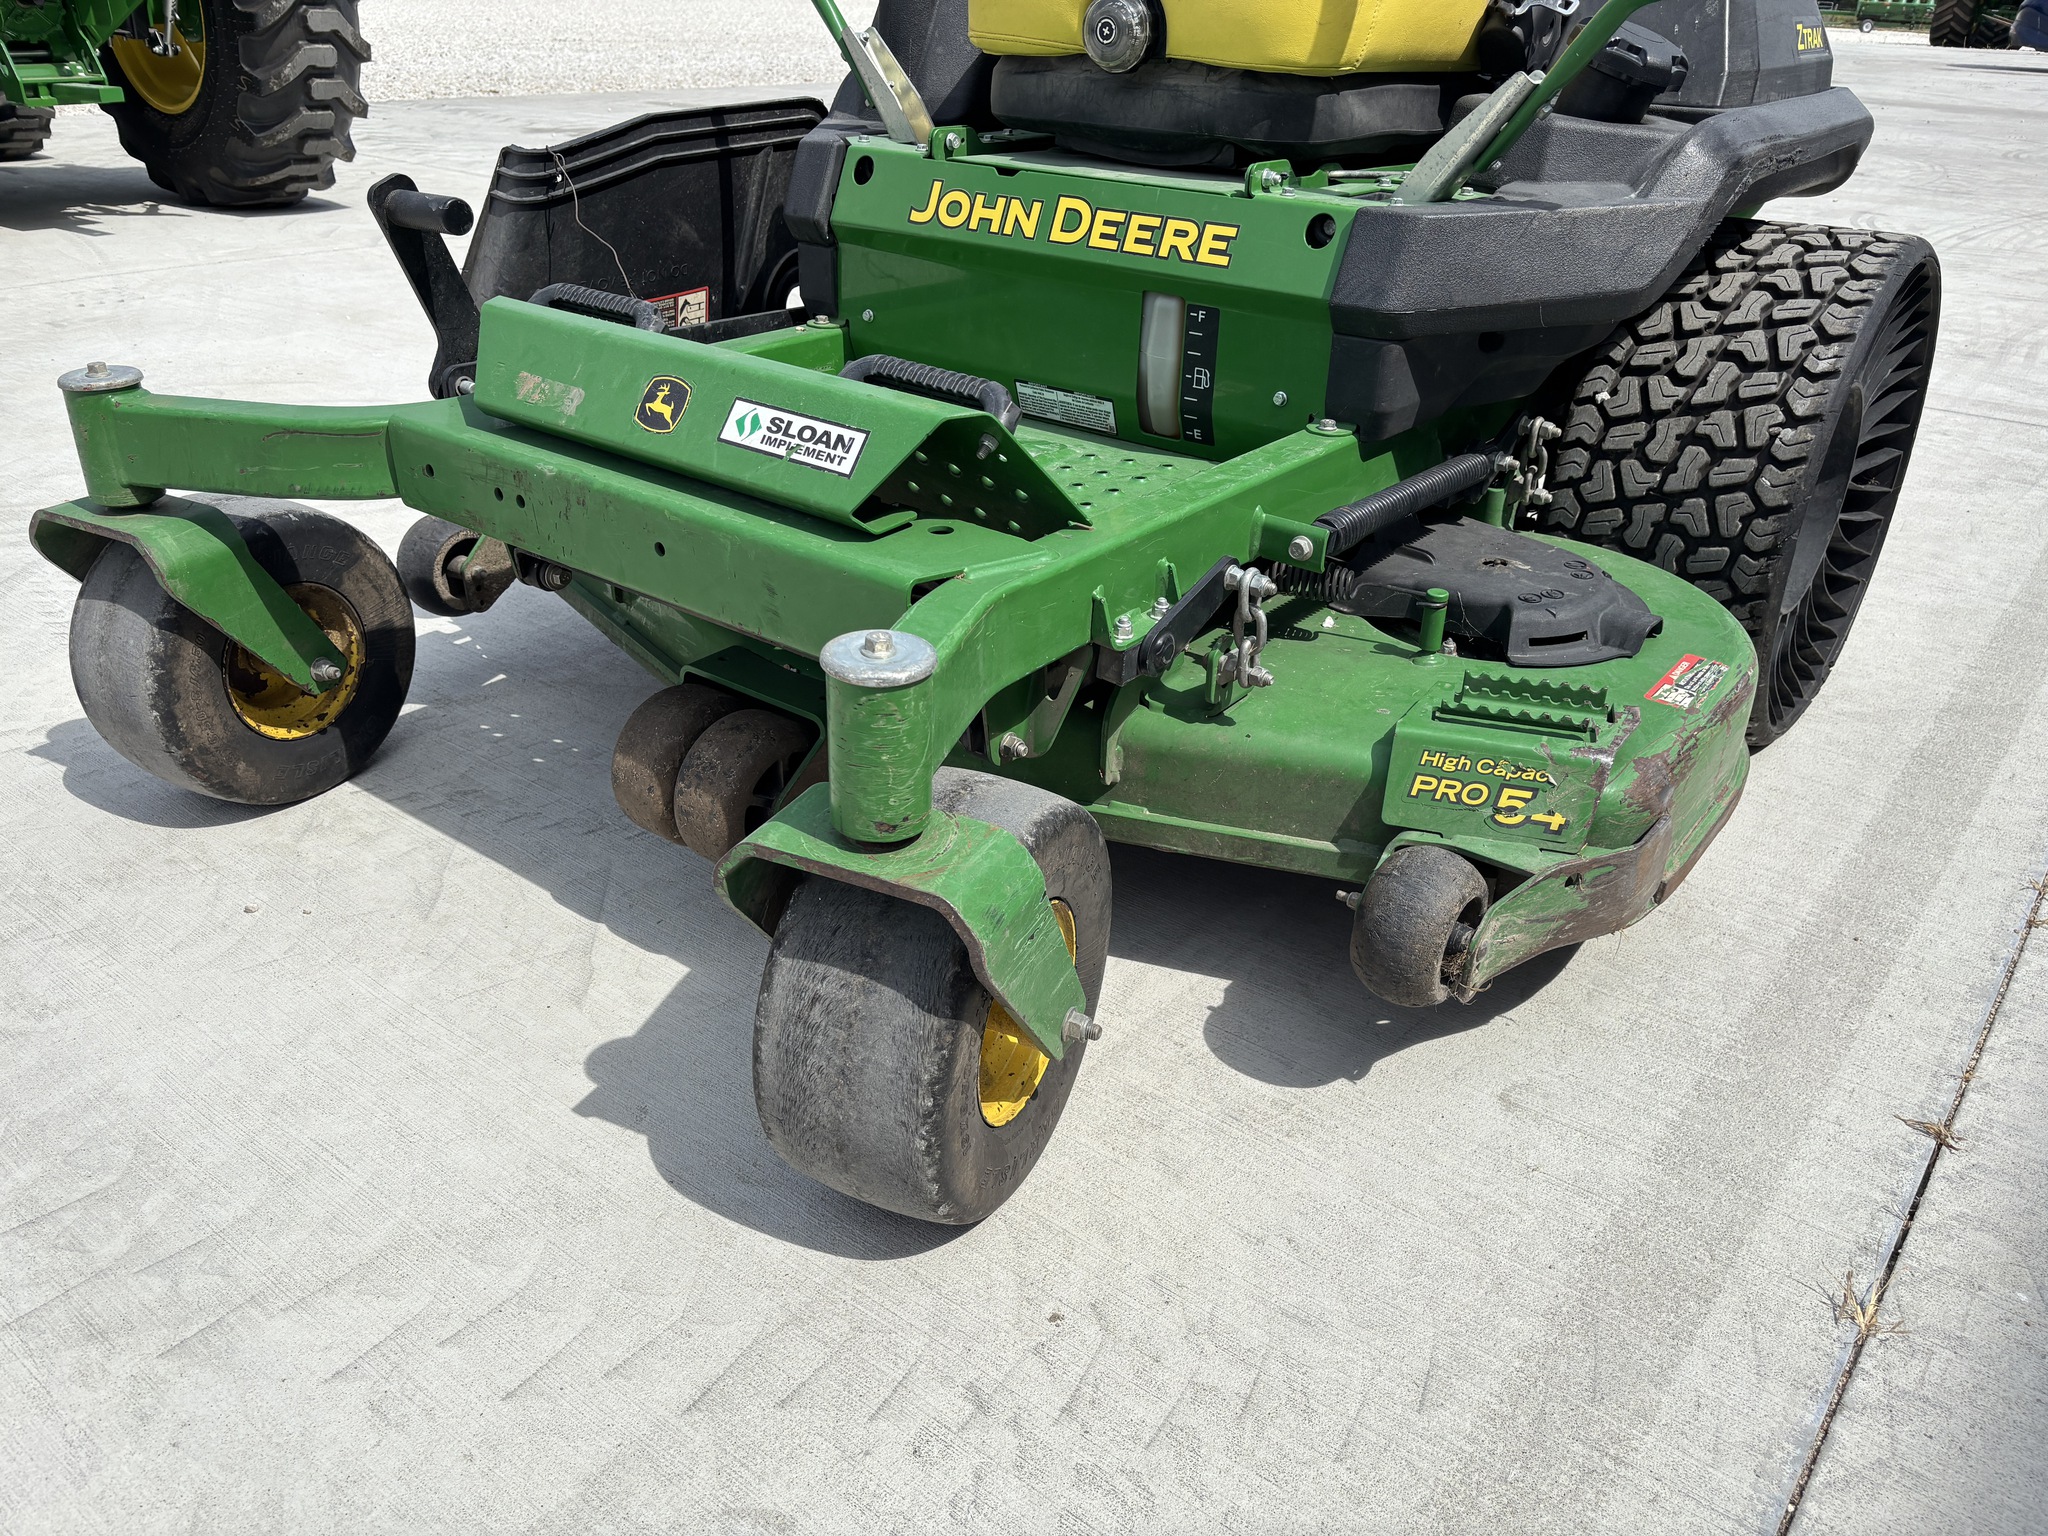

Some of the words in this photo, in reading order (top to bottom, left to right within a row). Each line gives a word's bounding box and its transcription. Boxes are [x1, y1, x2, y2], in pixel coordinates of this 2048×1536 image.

[1797, 24, 1823, 50] ZTRAK
[908, 179, 1043, 240] JOHN
[1048, 194, 1239, 269] DEERE
[1198, 310, 1207, 323] F
[766, 416, 855, 455] SLOAN
[1193, 429, 1203, 440] E
[1419, 749, 1471, 772] High
[1408, 774, 1490, 806] PRO
